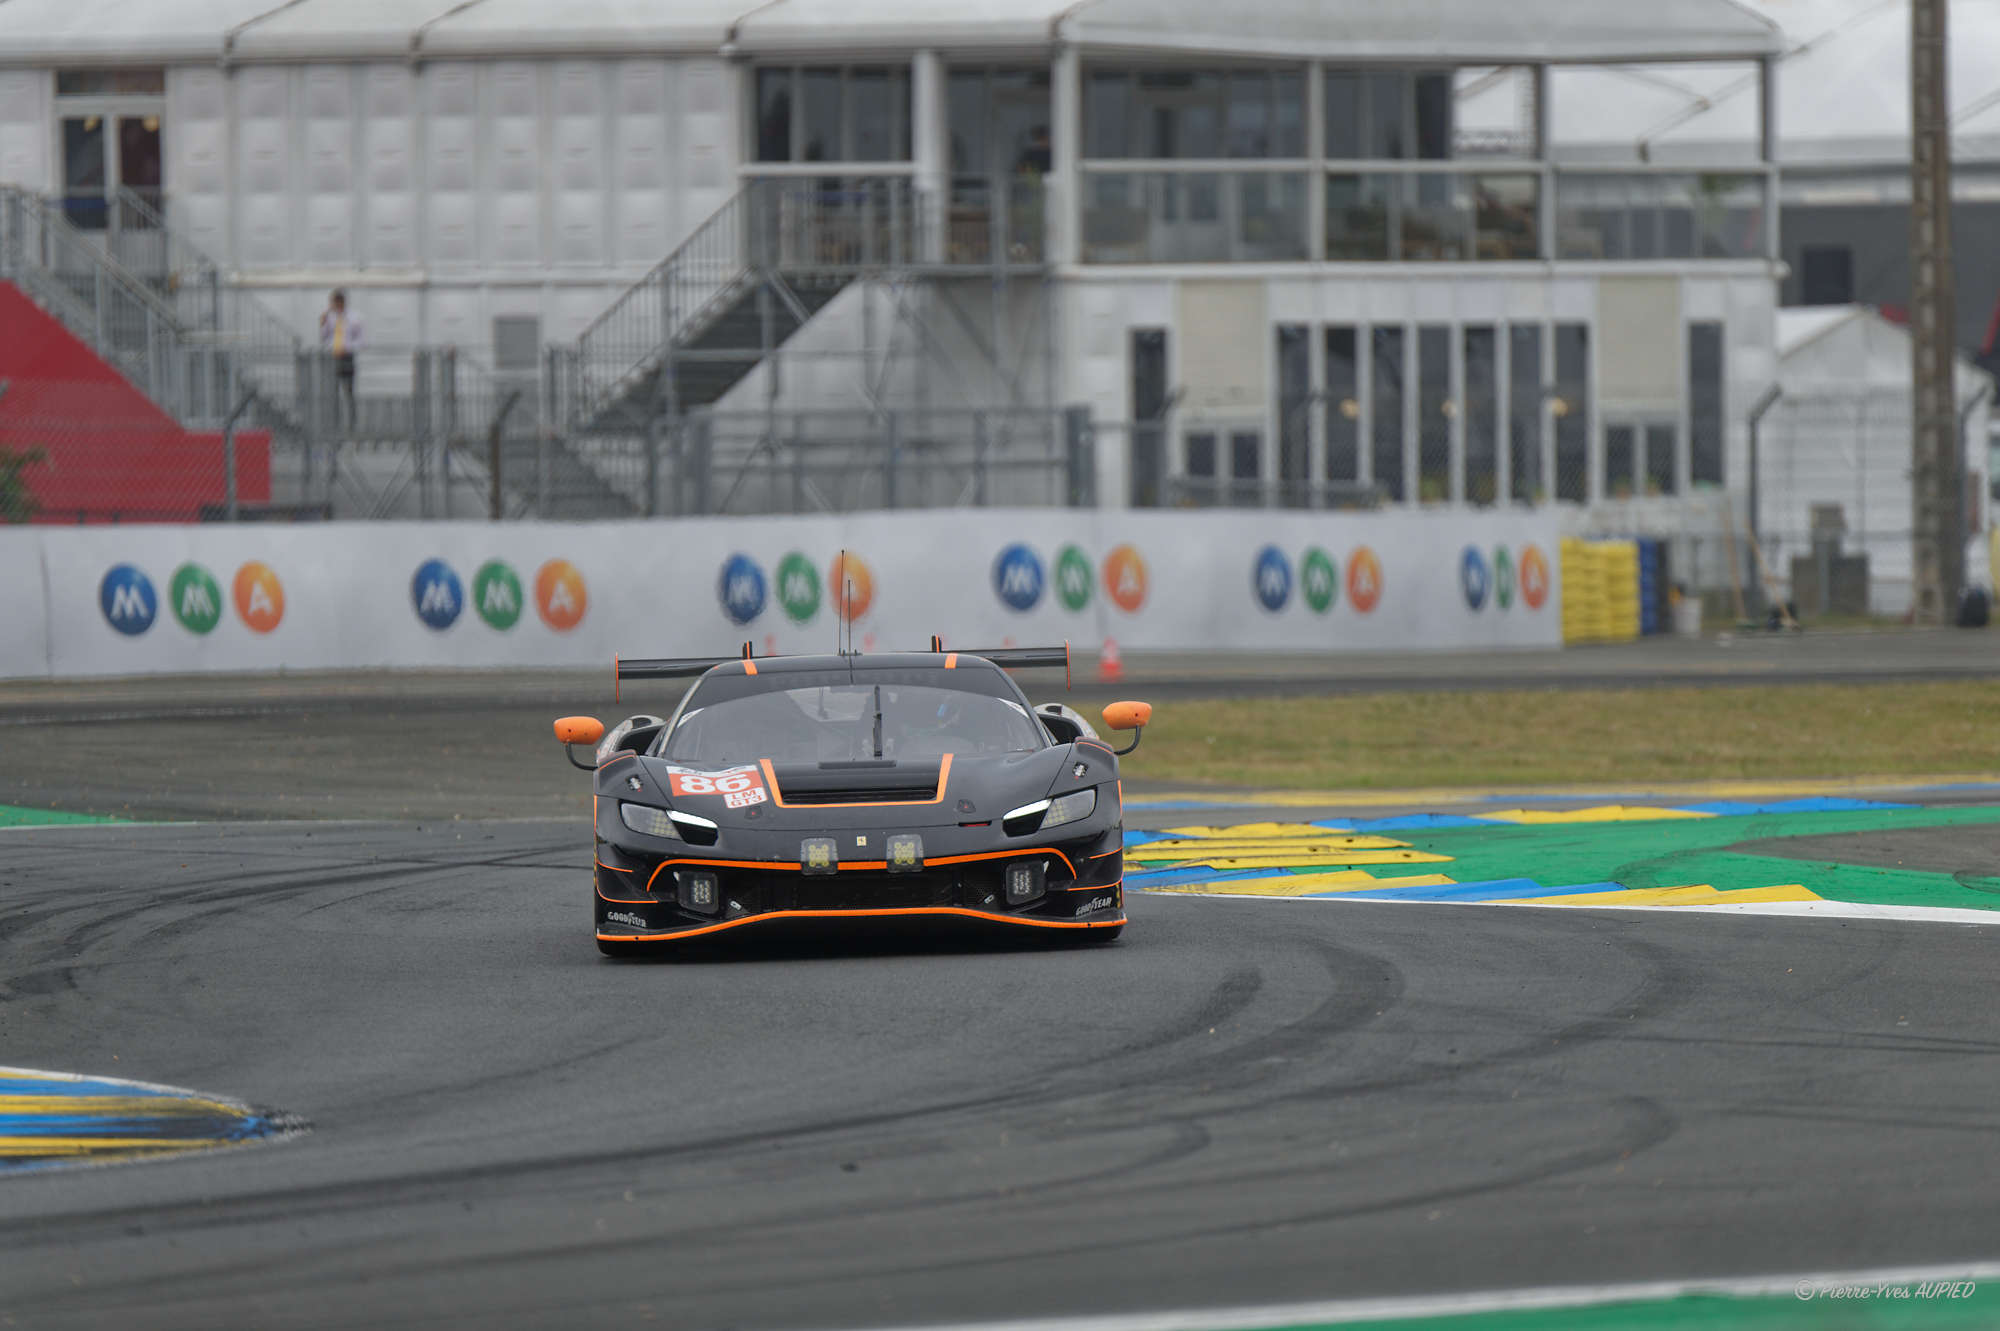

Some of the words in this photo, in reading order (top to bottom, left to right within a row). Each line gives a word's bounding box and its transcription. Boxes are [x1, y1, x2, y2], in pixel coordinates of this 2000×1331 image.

[680, 774, 751, 793] 86
[731, 789, 756, 800] LM
[730, 795, 763, 807] GT3
